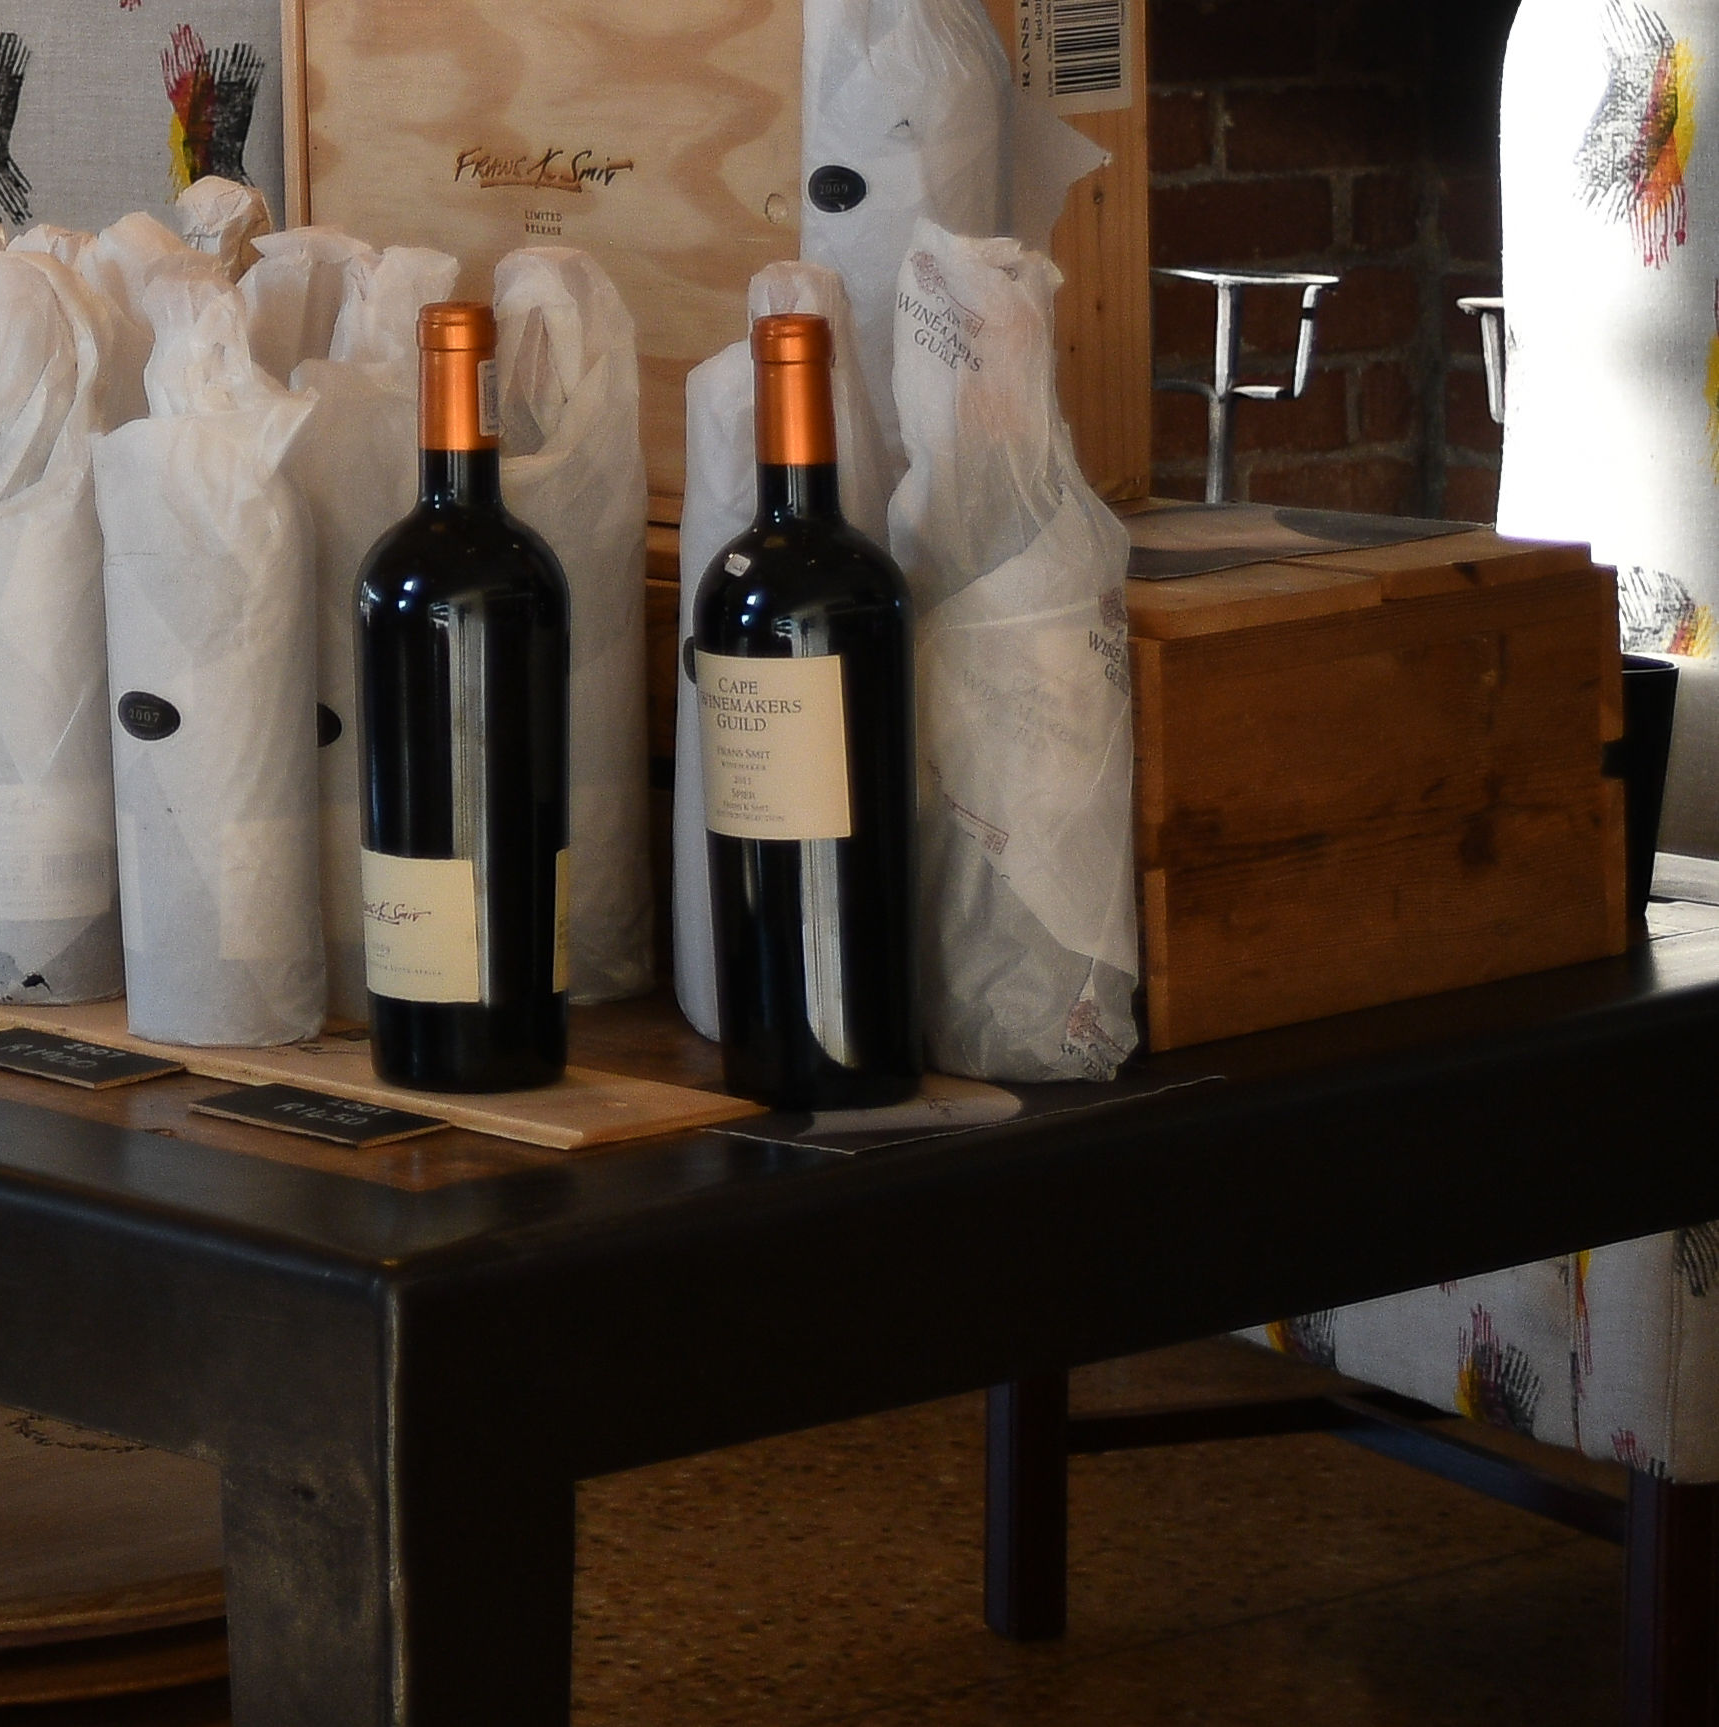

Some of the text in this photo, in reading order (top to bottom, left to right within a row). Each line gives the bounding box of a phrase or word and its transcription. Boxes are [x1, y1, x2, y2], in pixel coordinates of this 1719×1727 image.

[1020, 16, 1031, 93] RANS
[525, 210, 563, 223] LIMITED
[525, 223, 563, 235] RELEASE
[718, 678, 759, 695] CAPE
[129, 707, 160, 723] 2007
[716, 713, 767, 732] GUILD
[744, 748, 771, 760] SMIT
[63, 1043, 127, 1058] 2007
